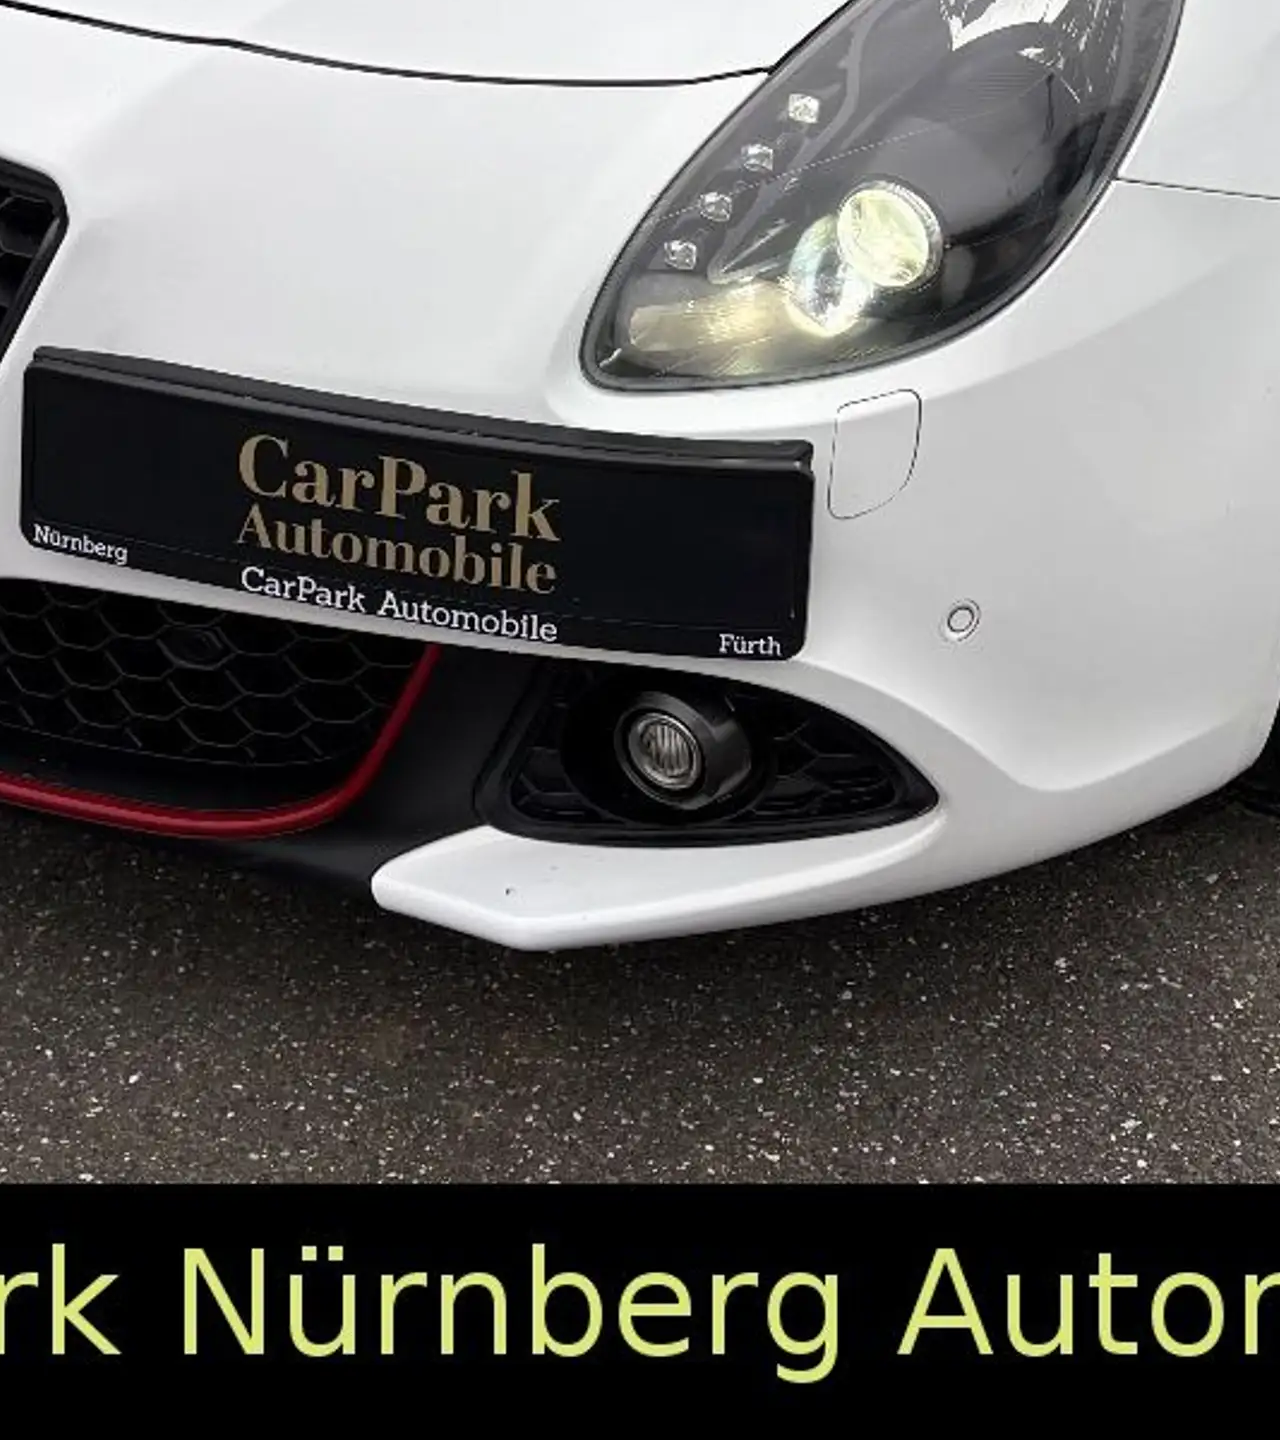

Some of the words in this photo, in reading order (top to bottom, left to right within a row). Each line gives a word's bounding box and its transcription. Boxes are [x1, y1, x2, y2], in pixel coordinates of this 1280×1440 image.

[238, 434, 561, 542] CarPark
[33, 523, 129, 566] Nürnberg
[236, 502, 557, 595] Automobile
[241, 566, 367, 613] CarPark
[377, 590, 558, 643] Automobile
[719, 633, 782, 657] Fürth
